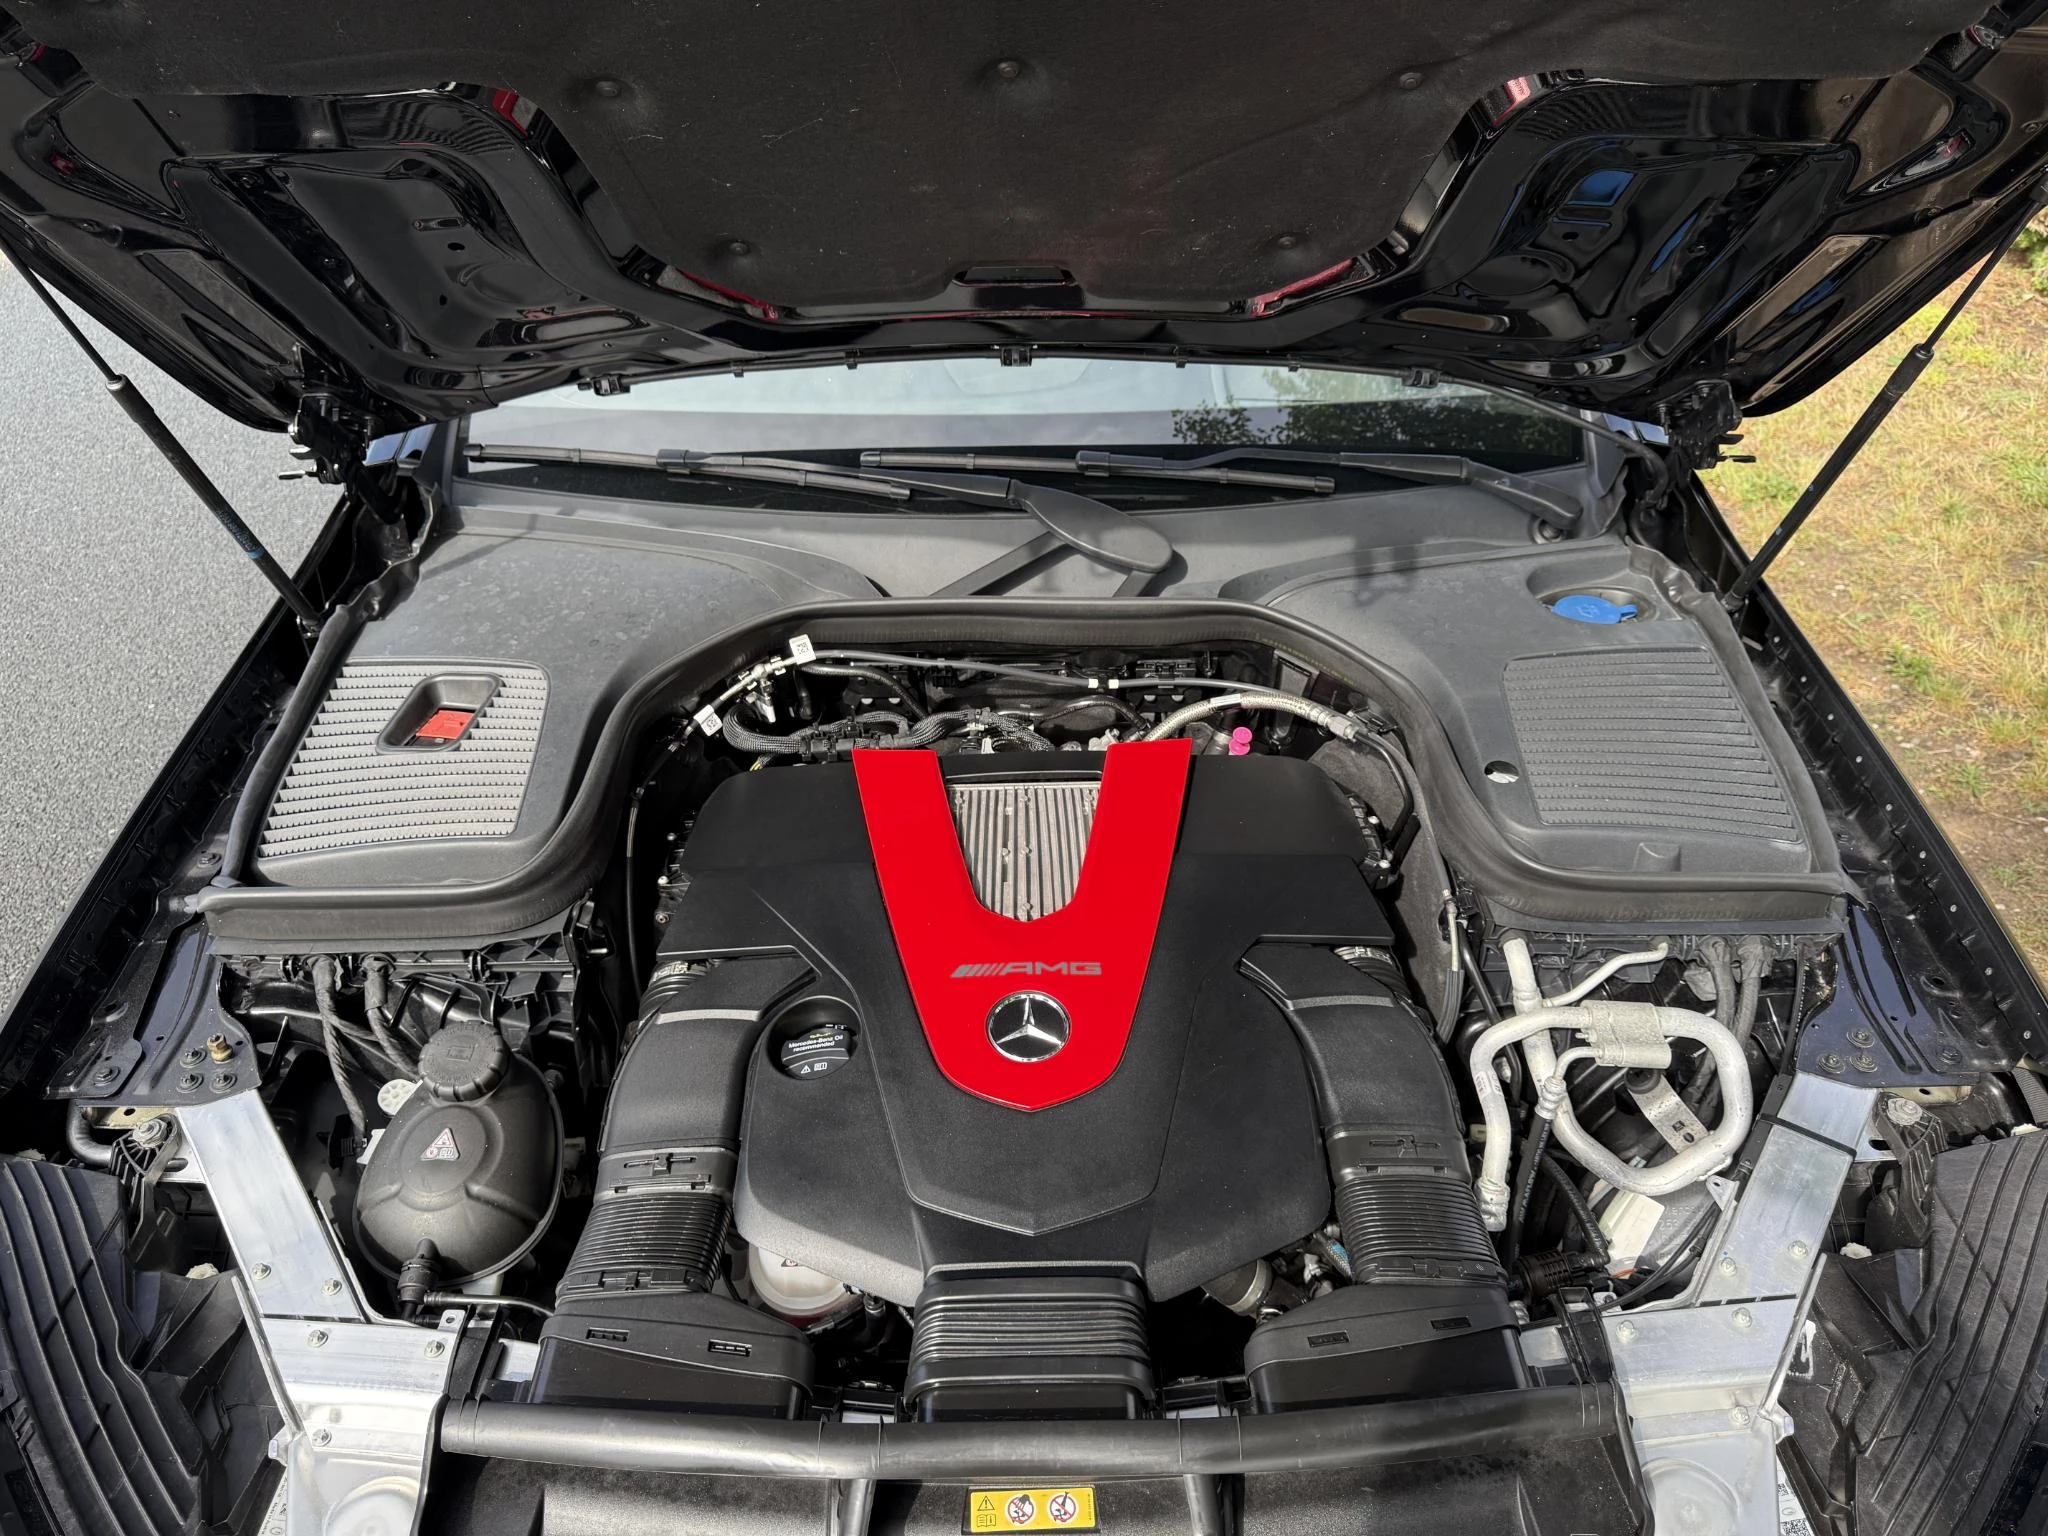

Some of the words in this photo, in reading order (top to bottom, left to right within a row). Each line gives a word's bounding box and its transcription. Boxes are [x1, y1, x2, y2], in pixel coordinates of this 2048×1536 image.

[999, 961, 1102, 976] AMG
[788, 1036, 833, 1049] Mercedes-Benz
[793, 1041, 835, 1052] recommended
